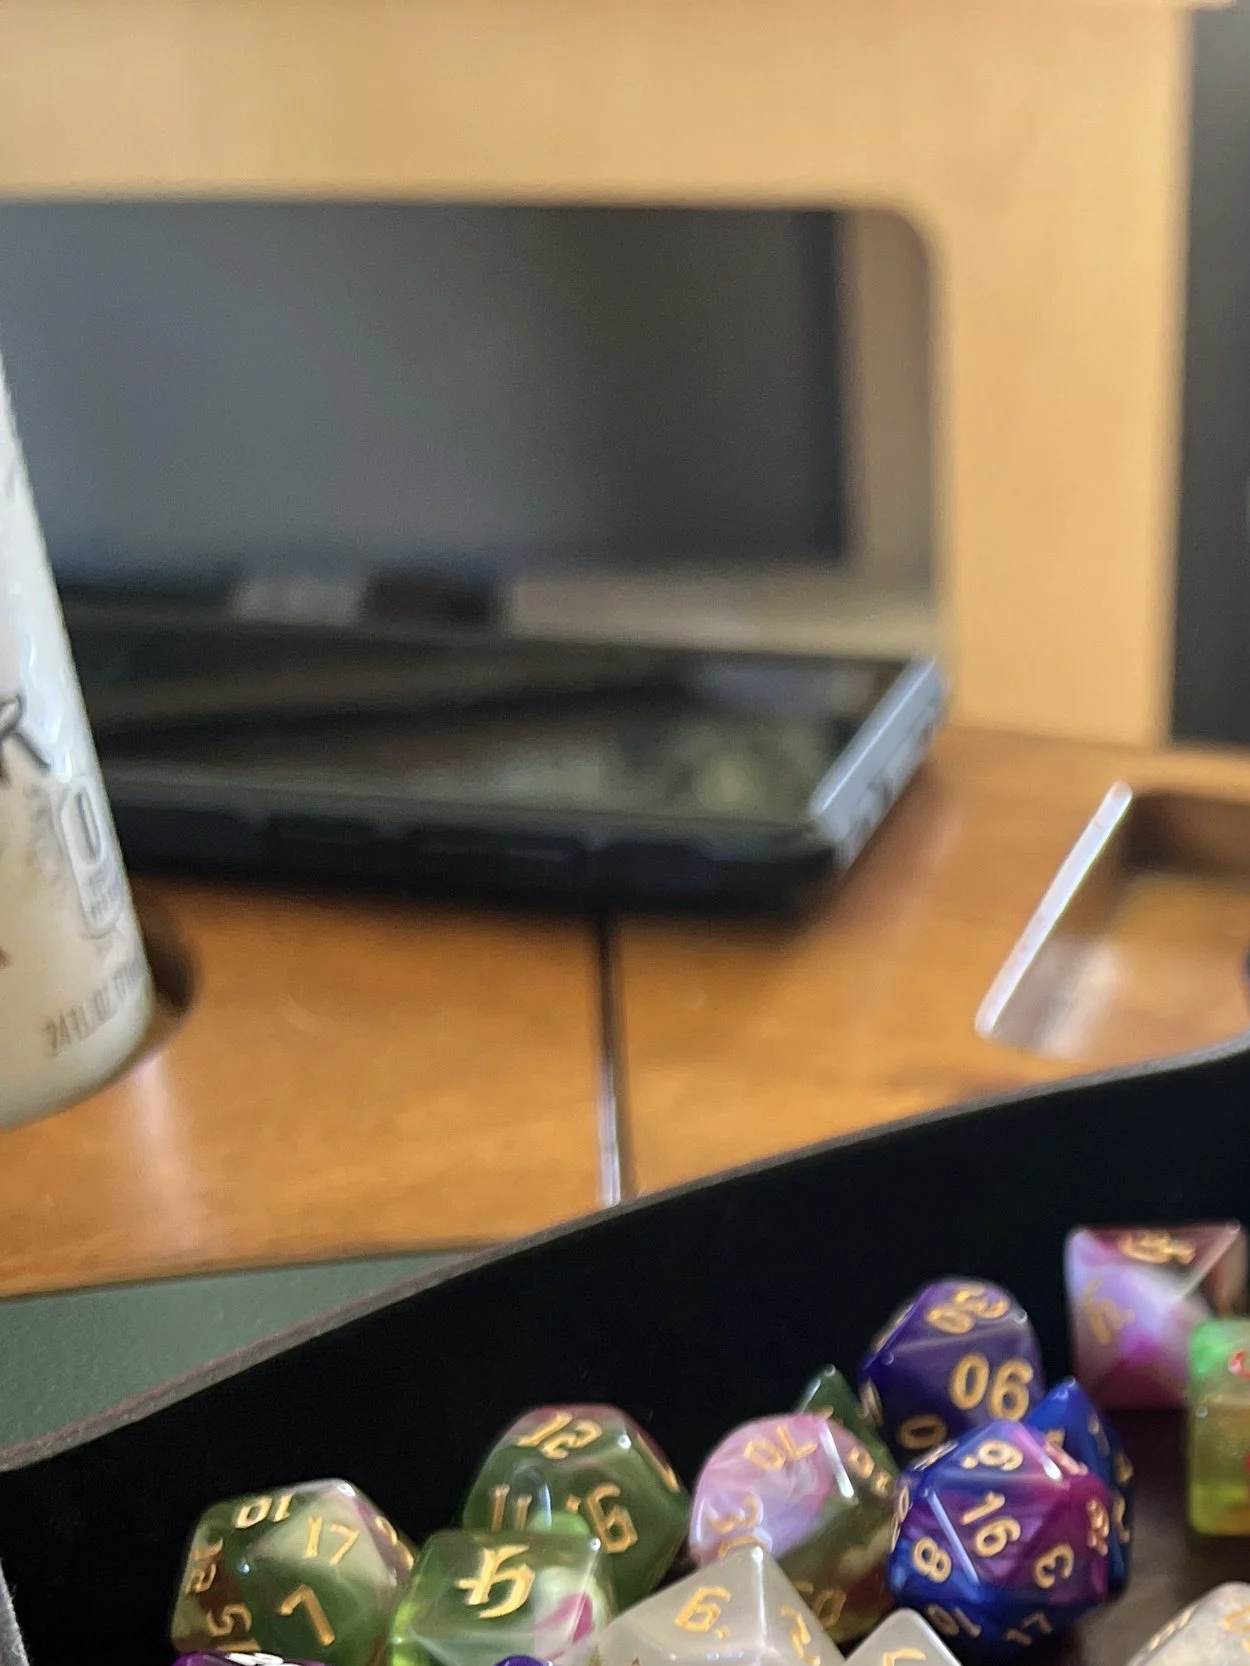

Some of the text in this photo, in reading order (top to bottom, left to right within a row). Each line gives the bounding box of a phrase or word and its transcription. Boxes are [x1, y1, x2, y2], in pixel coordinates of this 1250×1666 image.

[517, 1412, 602, 1459] 12
[236, 1493, 296, 1529] 10
[961, 1491, 1021, 1557] 16
[303, 1516, 360, 1566] 17
[912, 1536, 952, 1584] 8
[1033, 1543, 1075, 1589] 3
[279, 1584, 336, 1646] 7
